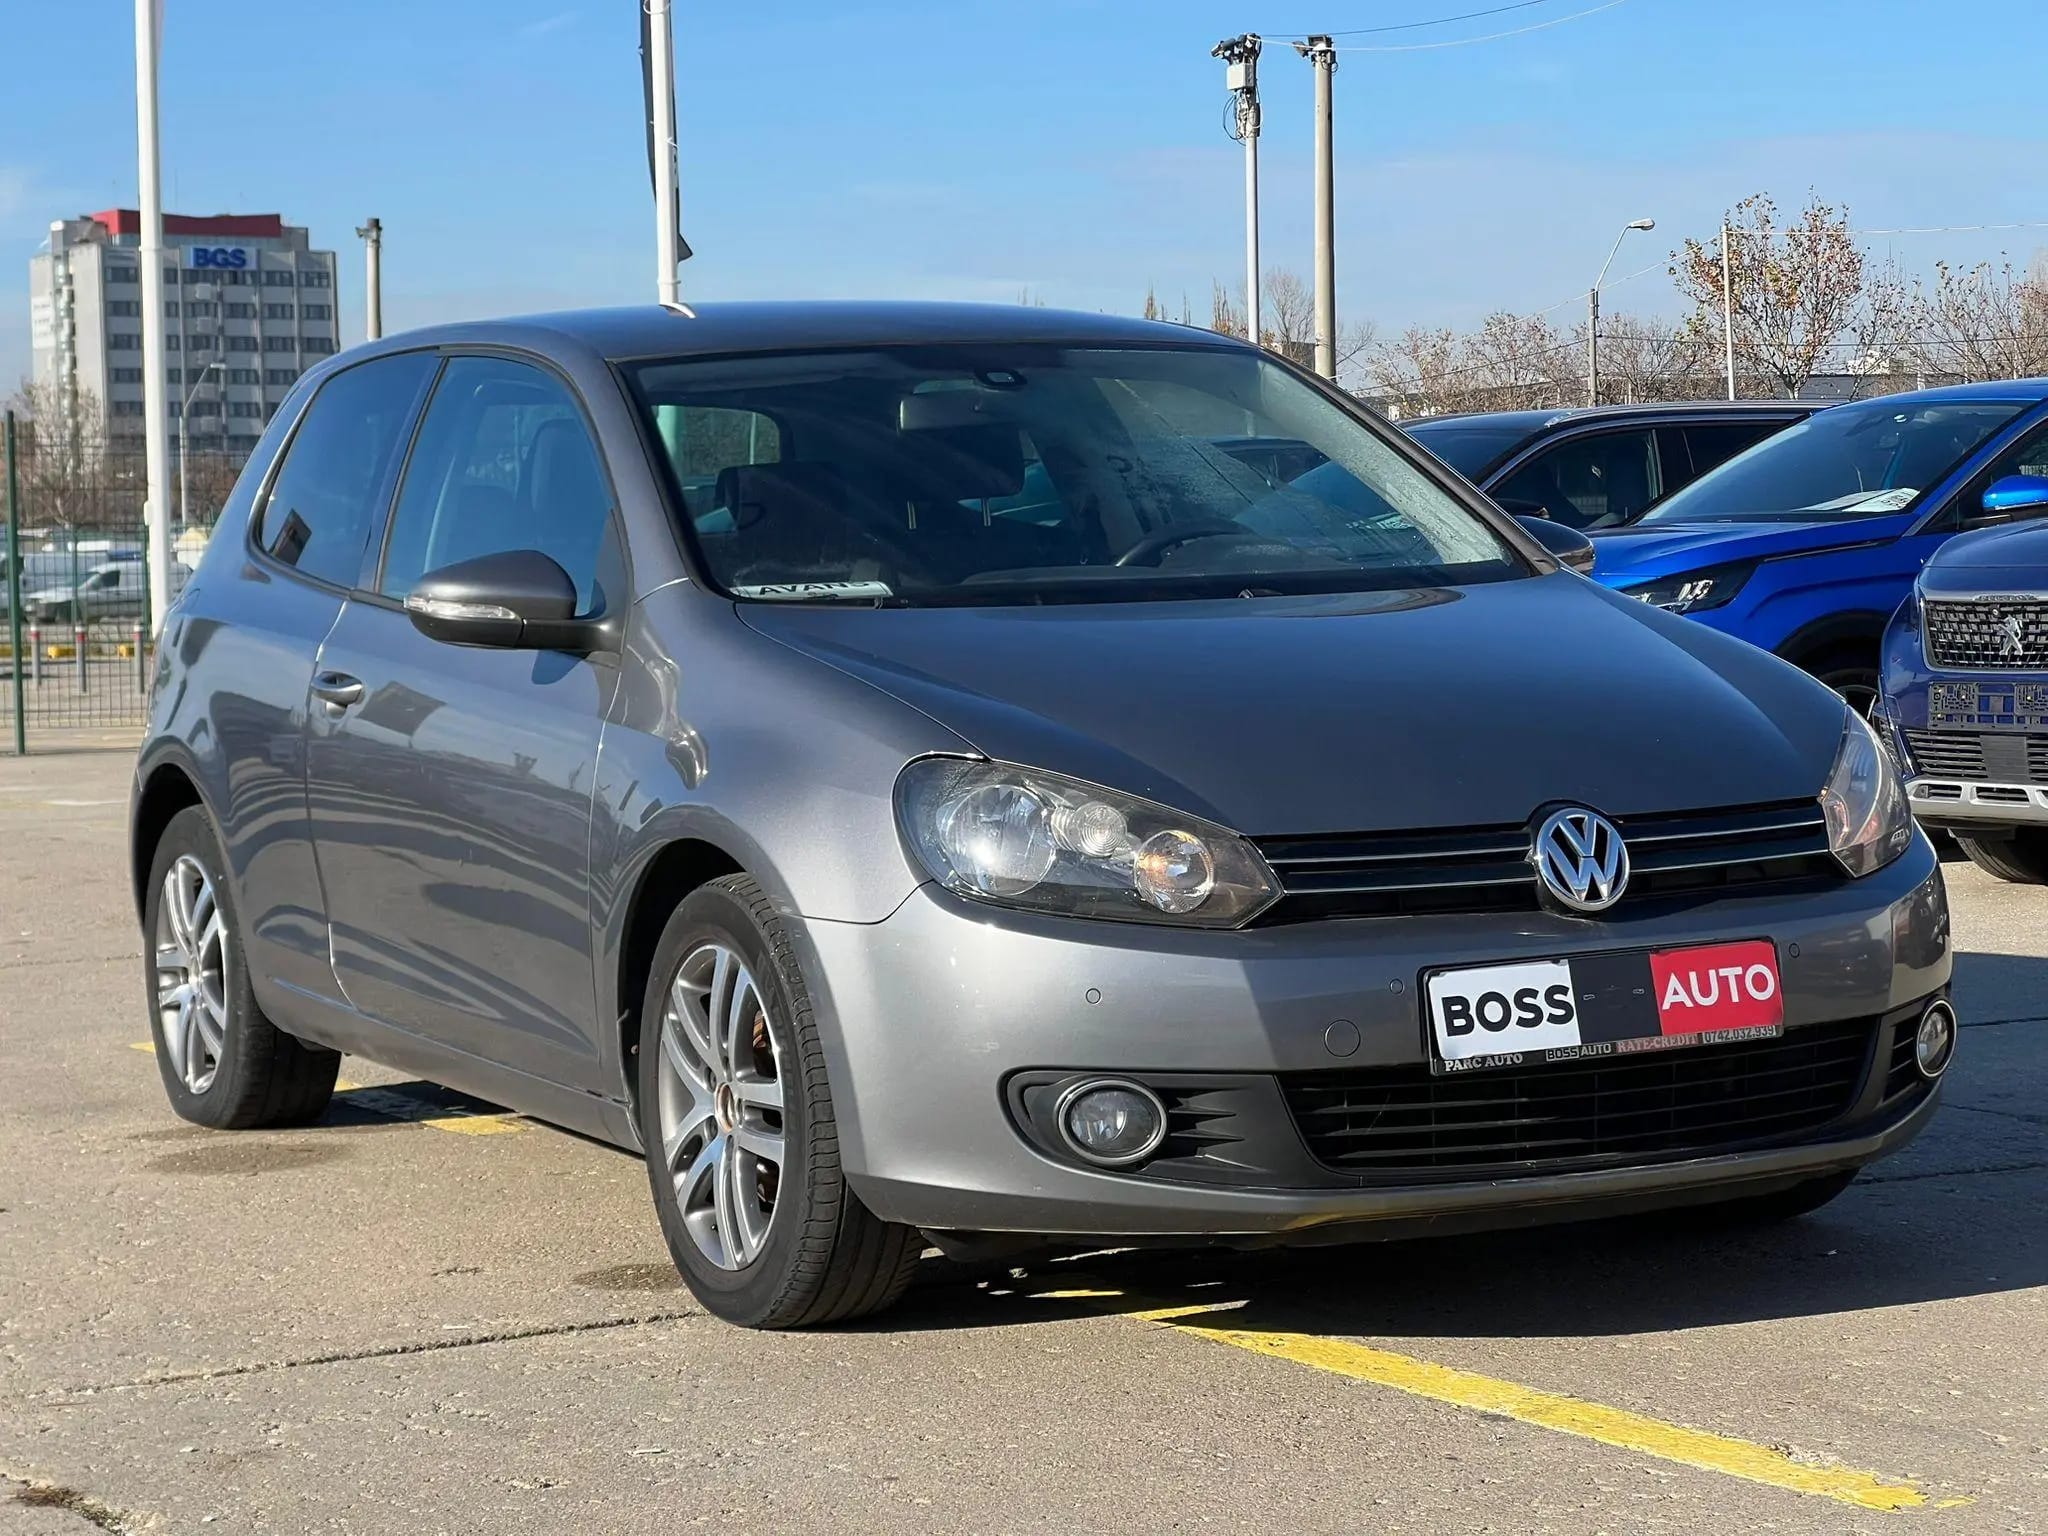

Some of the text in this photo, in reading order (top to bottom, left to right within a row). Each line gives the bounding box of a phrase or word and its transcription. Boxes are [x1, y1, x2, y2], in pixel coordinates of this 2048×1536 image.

[193, 247, 246, 269] BGS
[1442, 963, 1775, 1037] BOSS AUTO
[1444, 1058, 1482, 1072] PARC
[1484, 1053, 1523, 1068] AUTO
[1547, 1047, 1579, 1060] BOSS
[1580, 1043, 1612, 1056] AUTO
